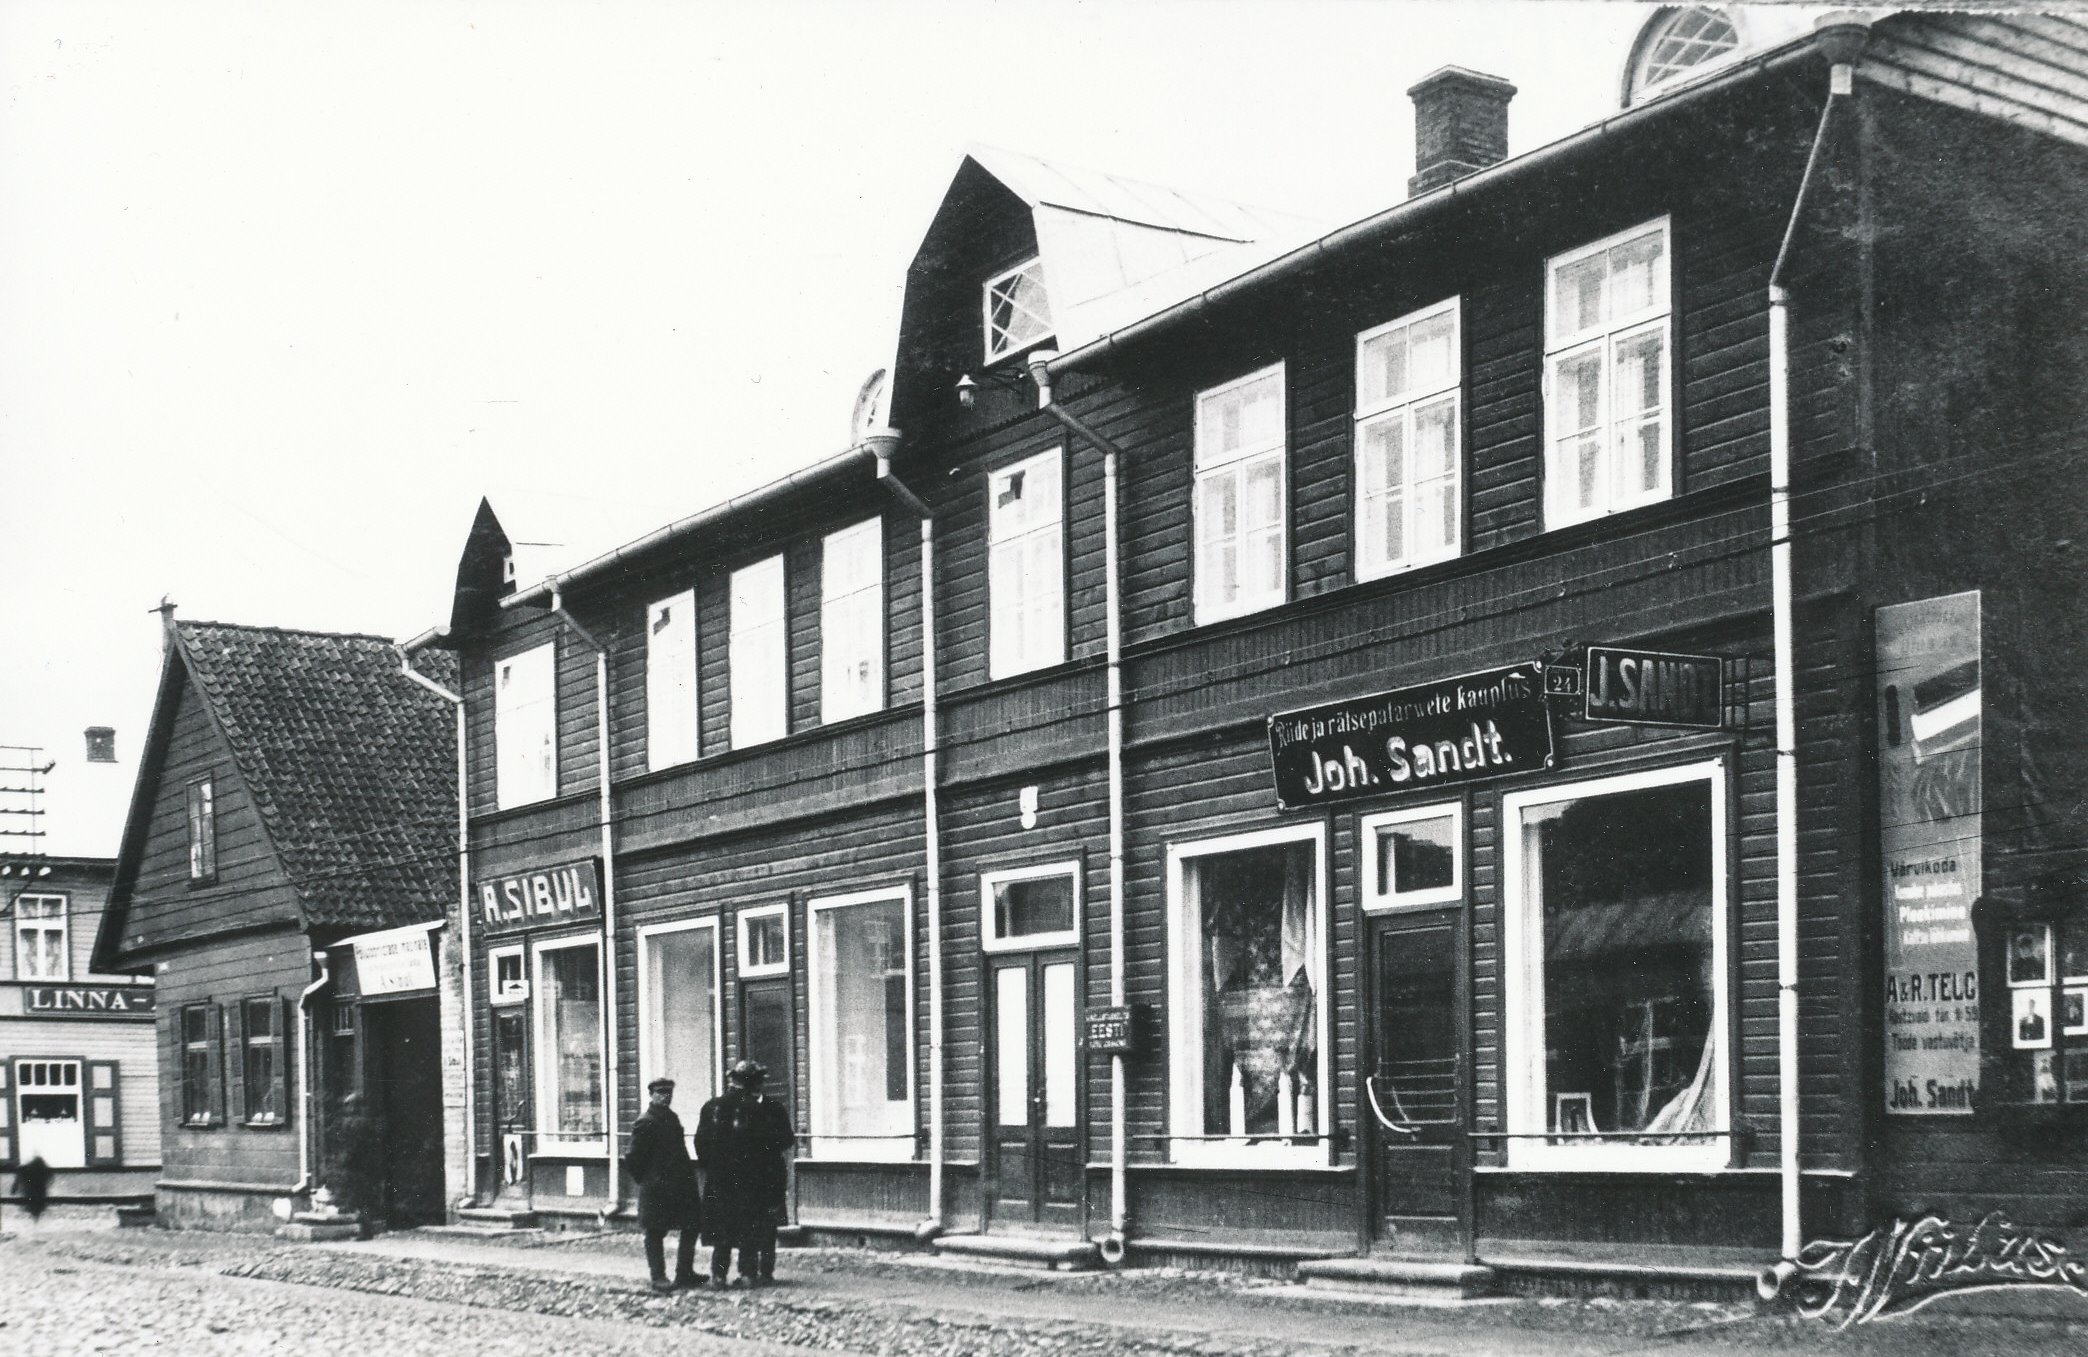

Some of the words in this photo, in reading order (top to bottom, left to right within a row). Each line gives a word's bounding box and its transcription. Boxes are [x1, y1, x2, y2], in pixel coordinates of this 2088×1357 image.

[1275, 719, 1309, 749] Riide
[1311, 717, 1325, 743] ja
[1304, 744, 1380, 794] Joh.
[1386, 719, 1513, 783] Sandt.
[482, 867, 594, 925] A.SIBUL
[1091, 1023, 1124, 1038] EESTI
[1890, 1079, 1923, 1109] Joh.
